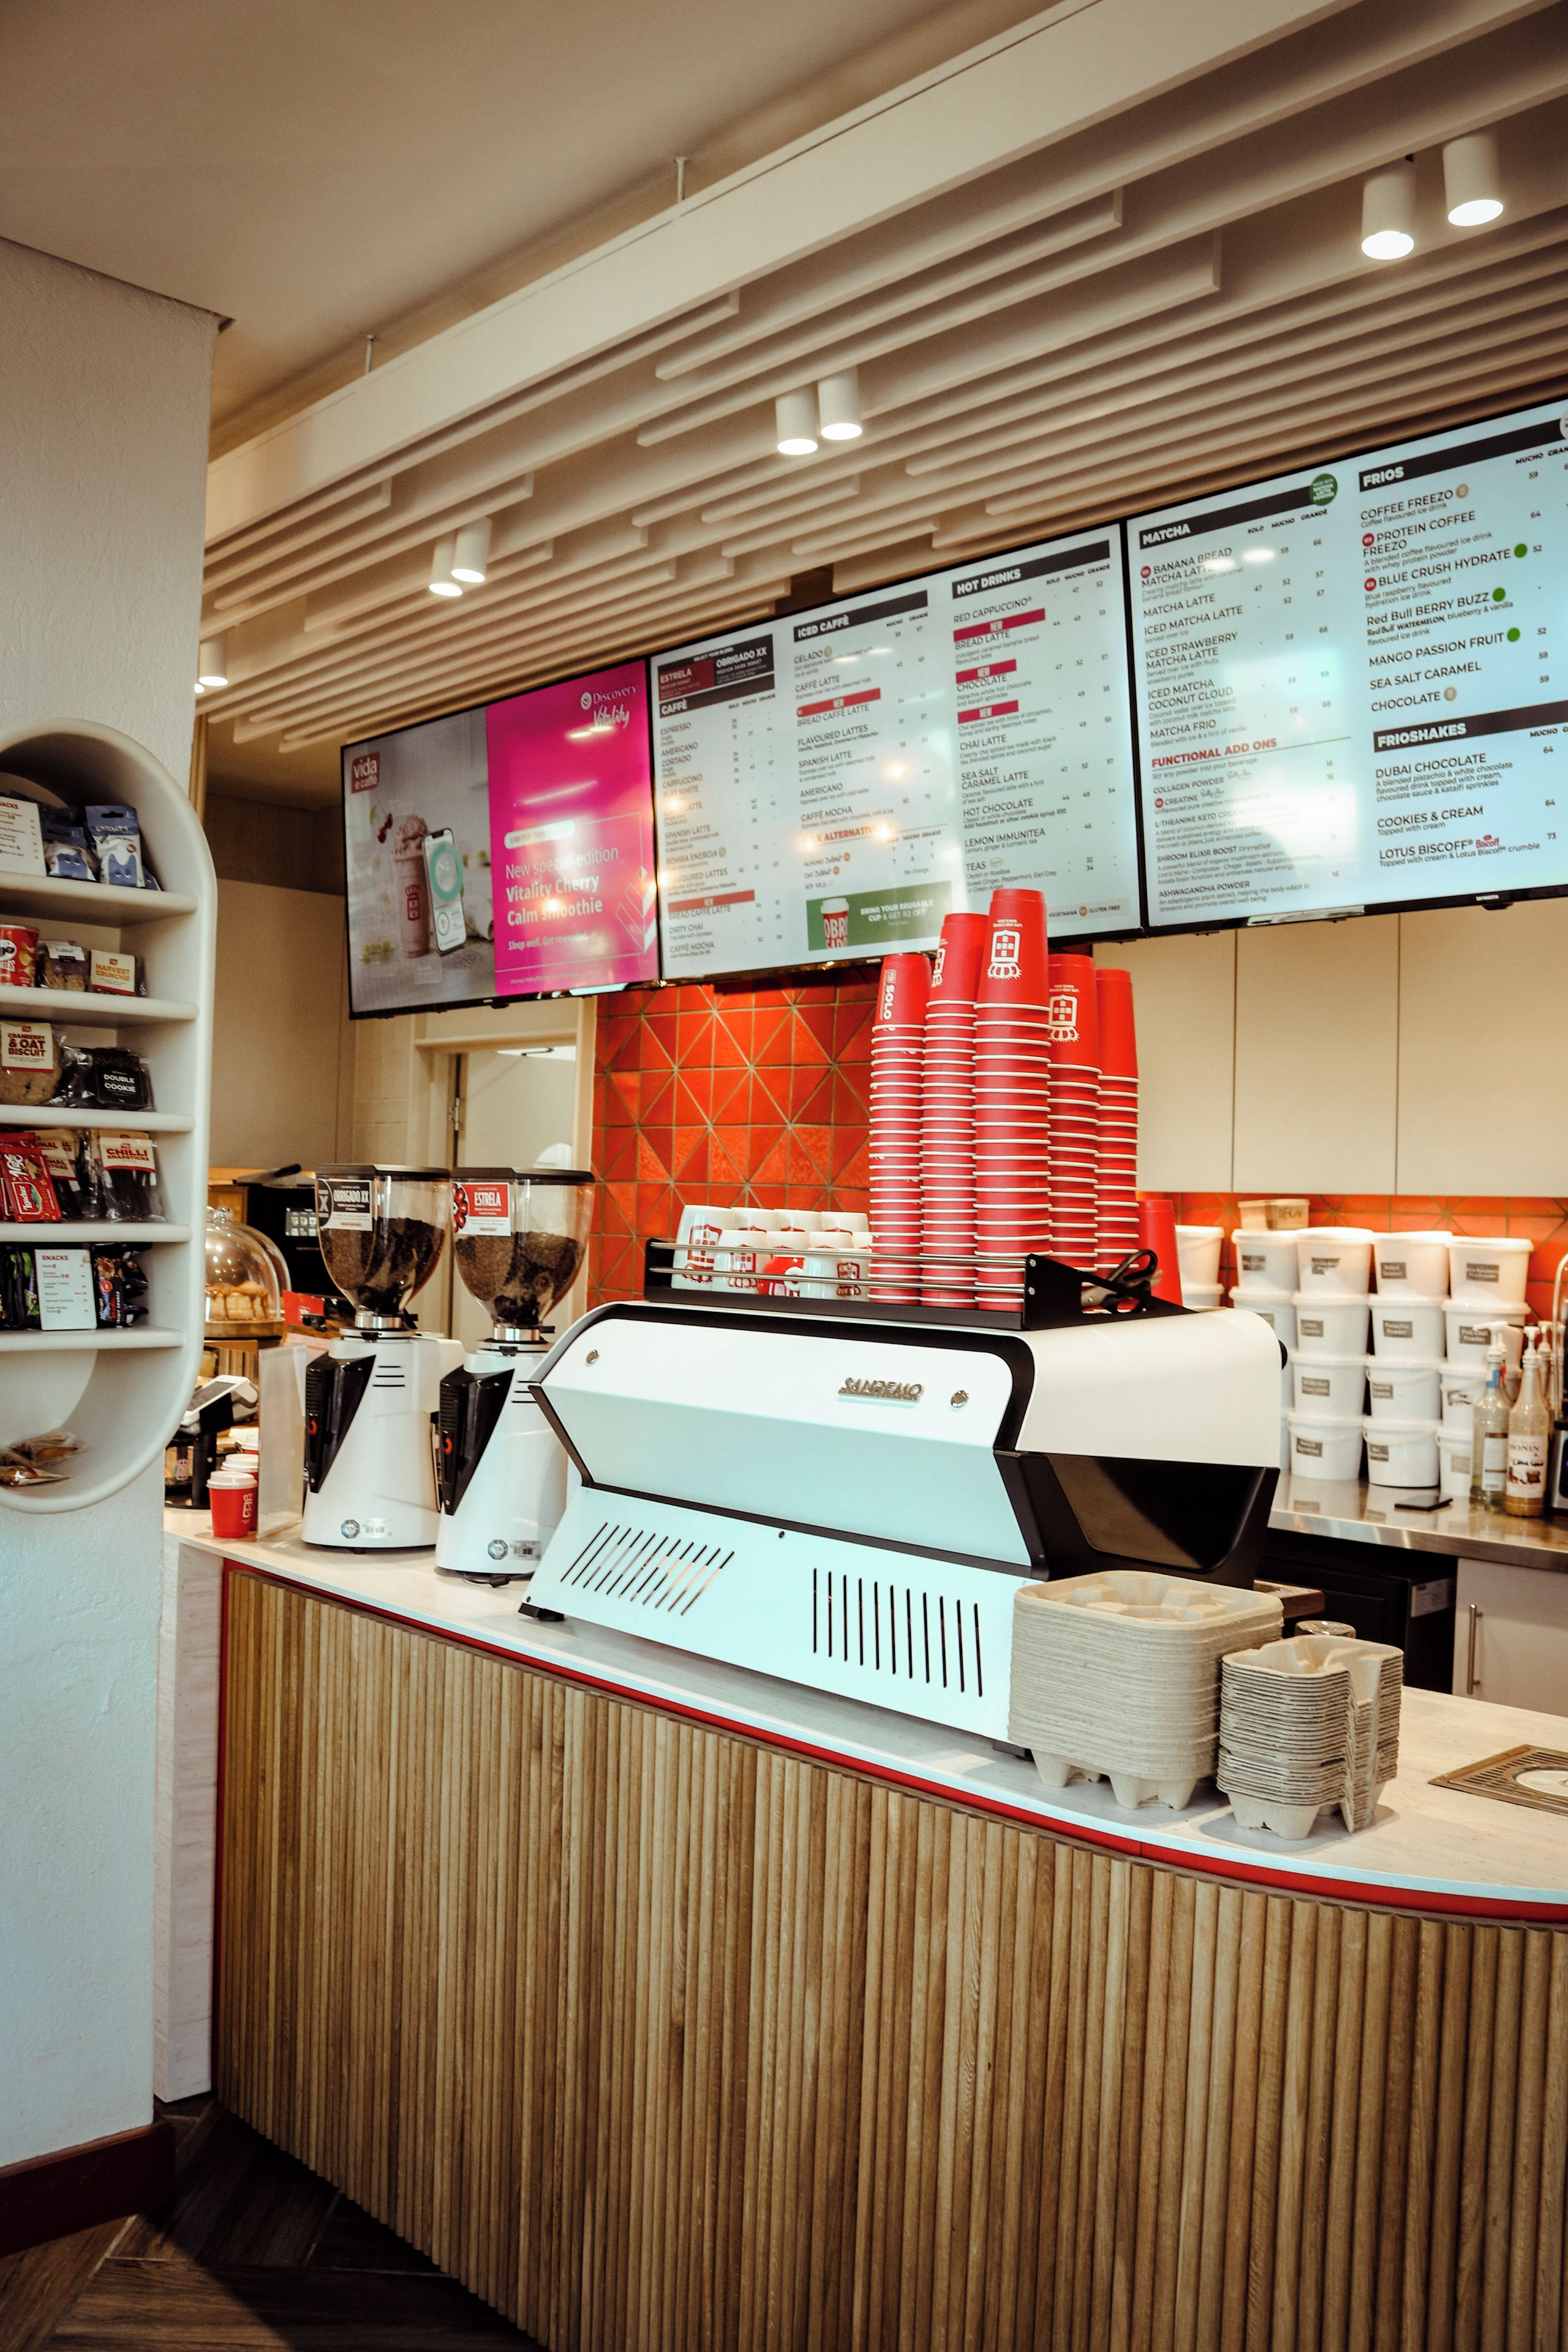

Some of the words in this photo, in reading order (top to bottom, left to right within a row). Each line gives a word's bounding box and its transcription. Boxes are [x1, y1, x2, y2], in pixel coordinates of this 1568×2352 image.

[1515, 453, 1543, 464] MUCHO
[1363, 467, 1404, 487] FRIOS
[1360, 502, 1404, 521] COFFEE
[1408, 490, 1453, 509] FREEZO
[1384, 511, 1416, 525] flavoured
[1428, 502, 1447, 512] drink
[1272, 519, 1294, 527] MUCHO
[1377, 523, 1426, 542] PROTEIN
[1430, 511, 1476, 530] COFFEE
[1142, 524, 1191, 545] MATCHA
[1363, 540, 1407, 557] FREEZO
[1153, 557, 1195, 574] BANANA
[1198, 548, 1232, 562] BREAD
[1379, 571, 1409, 587] BLUE
[1411, 562, 1451, 580] CRUSH
[1455, 549, 1511, 570] HYDRATE
[957, 581, 979, 595] HOT
[981, 568, 1021, 588] DRINKS
[1142, 571, 1183, 588] MATCHA
[1144, 601, 1183, 617] MATCHA
[1186, 594, 1215, 608] LATTE
[1366, 614, 1388, 626] Red
[1390, 609, 1412, 620] Bull
[1415, 598, 1454, 616] BERRY
[1457, 592, 1490, 607] BUZZ
[797, 626, 818, 638] ICED
[820, 615, 850, 632] CAFFÈ
[954, 613, 970, 624] RED
[1144, 624, 1167, 635] ICED
[1169, 613, 1211, 630] MATCHA
[1213, 606, 1243, 620] LATTE
[955, 636, 984, 650] BREAD
[985, 630, 1010, 643] LATTE
[1146, 647, 1168, 659] ICED
[1170, 632, 1238, 654] STRAWBERRY
[717, 649, 755, 668] OBRIGADO
[756, 647, 767, 656] XX
[794, 650, 823, 663] GELADO
[1147, 653, 1186, 669] MATCHA
[1189, 647, 1219, 662] LATTE
[1369, 650, 1413, 667] MANGO
[1415, 640, 1466, 658] PASSION
[1469, 633, 1504, 648] FRUIT
[660, 668, 692, 683] ESTRELA
[819, 675, 840, 686] LATTE
[957, 675, 1006, 692] CHOCOLATE
[1370, 678, 1392, 690] SEA
[1394, 672, 1422, 686] SALT
[1425, 662, 1482, 679] CARAMEL
[592, 684, 637, 703] Discovery
[1148, 688, 1170, 699] ICED
[1172, 679, 1215, 695] MATCHA
[1148, 693, 1196, 710] COCONUT
[1199, 687, 1233, 701] CLOUD
[1371, 692, 1441, 712] CHOCOLATE
[797, 731, 840, 745] FLAVOURED
[842, 724, 868, 736] LATTES
[1150, 725, 1191, 739] MATCHA
[1193, 720, 1216, 731] FRIO
[1377, 723, 1467, 748] FRIOSHAKES
[1529, 728, 1558, 737] MUCHO
[662, 742, 698, 756] AMERICANO
[1152, 748, 1221, 768] FUNCTIONAL
[1225, 743, 1250, 756] ADD
[1253, 738, 1278, 750] ONS
[353, 758, 377, 778] vida
[961, 771, 976, 781] SEA
[979, 767, 998, 777] SALT
[1376, 766, 1412, 778] DUBAI
[1415, 753, 1487, 773] CHOCOLATE
[801, 783, 843, 797] AMERICANO
[962, 777, 1001, 790] CARAMEL
[1003, 771, 1029, 782] LATTE
[1153, 782, 1190, 794] COLLAGEN
[1192, 777, 1224, 788] POWDER
[963, 807, 980, 816] HOT
[982, 798, 1033, 813] CHOCOLATE
[1165, 794, 1198, 805] CREATINE
[1378, 813, 1428, 828] COOKIES
[1431, 812, 1438, 821] &
[1441, 806, 1484, 820] CREAM
[965, 835, 994, 847] LEMON
[996, 828, 1046, 842] IMMUNITEA
[1157, 851, 1188, 862] SHROOM
[1190, 848, 1211, 858] ELIXIR
[1213, 846, 1237, 855] BOOST
[1379, 846, 1415, 860] LOTUS
[1456, 850, 1476, 859] Lotus
[1508, 842, 1540, 852] crumble
[505, 864, 530, 879] New
[966, 862, 986, 871] TEAS
[505, 883, 551, 903] Vitality
[555, 873, 599, 896] Cherry
[1159, 884, 1215, 898] ASHWAGANDHA
[1217, 881, 1250, 891] POWDER
[507, 908, 538, 926] Calm
[881, 903, 898, 912] YOUR
[508, 940, 524, 951] Sleep
[96, 963, 130, 975] HARVEST
[96, 970, 130, 981] CRUNCHIE
[884, 985, 895, 1020] SOLO
[9, 1039, 17, 1047] &
[19, 1039, 45, 1049] OAT
[9, 1048, 46, 1057] BISCUIT
[104, 1074, 135, 1084] DOUBLE
[105, 1083, 136, 1093] COOKIE
[474, 1192, 502, 1207] ESTRELA
